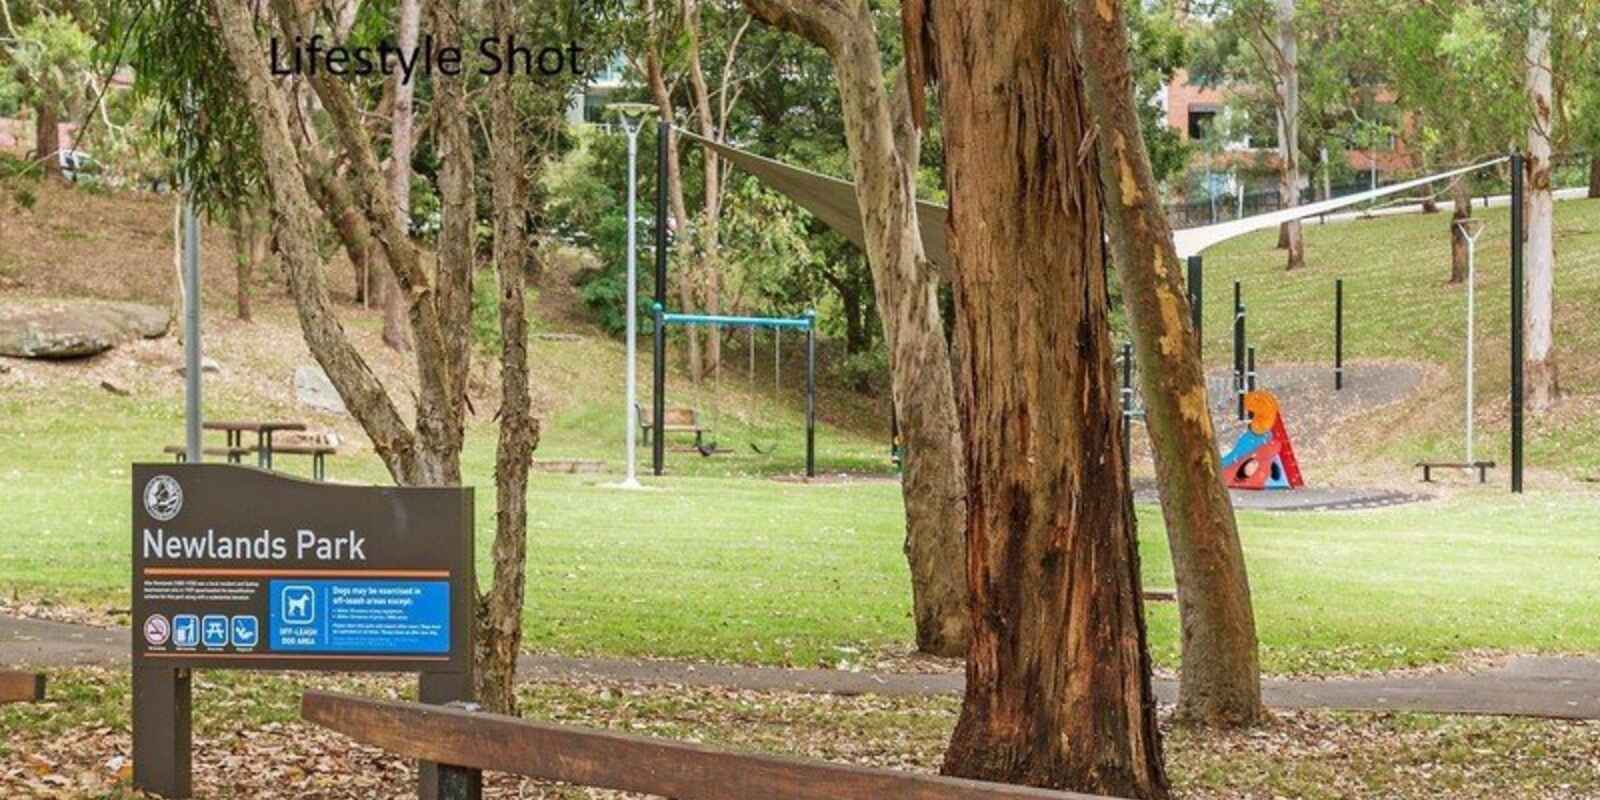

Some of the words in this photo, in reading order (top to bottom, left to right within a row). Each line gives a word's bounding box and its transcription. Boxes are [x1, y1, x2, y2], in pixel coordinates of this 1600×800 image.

[143, 528, 287, 560] Newlands
[297, 529, 367, 561] Park
[332, 586, 351, 596] Dogs
[352, 587, 367, 597] may
[297, 637, 316, 646] AREA
